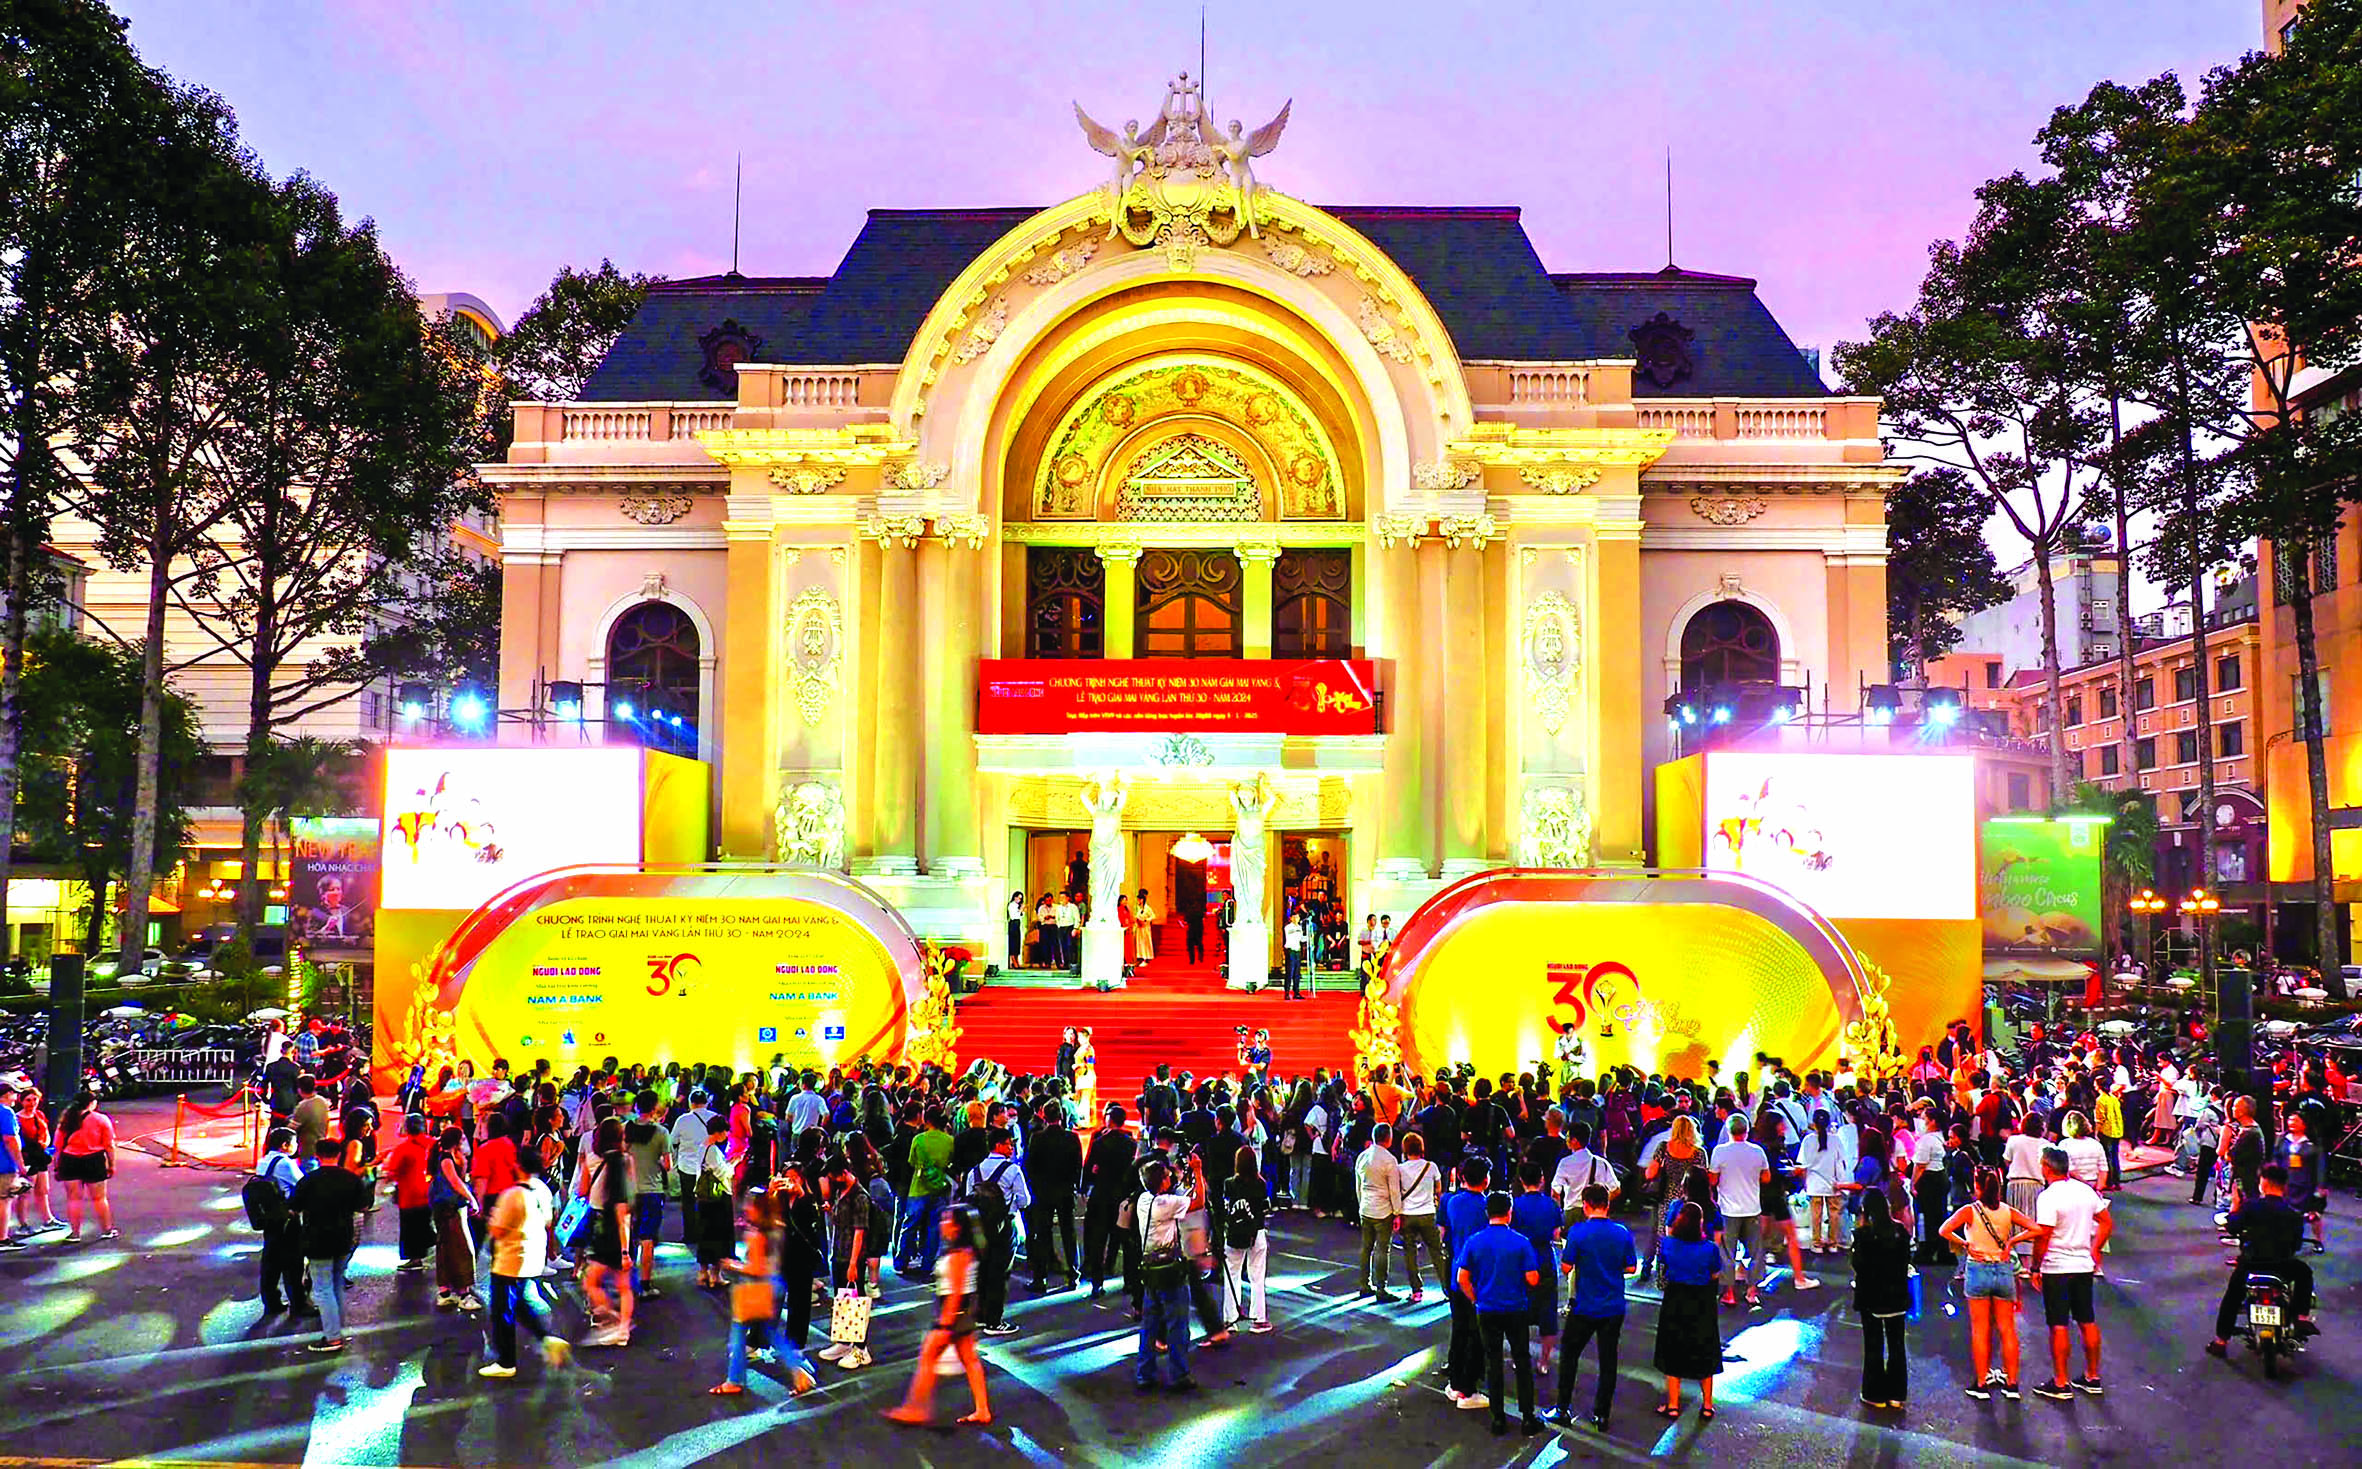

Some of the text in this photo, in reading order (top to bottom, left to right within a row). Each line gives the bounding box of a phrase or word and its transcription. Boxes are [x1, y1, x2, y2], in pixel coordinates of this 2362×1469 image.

[721, 914, 736, 924] 30
[783, 915, 800, 924] MAI
[576, 929, 606, 939] TRAO
[631, 929, 648, 938] MAI
[727, 929, 742, 938] 30
[776, 929, 810, 939] 2024
[528, 995, 603, 1004] NAM A BANK
